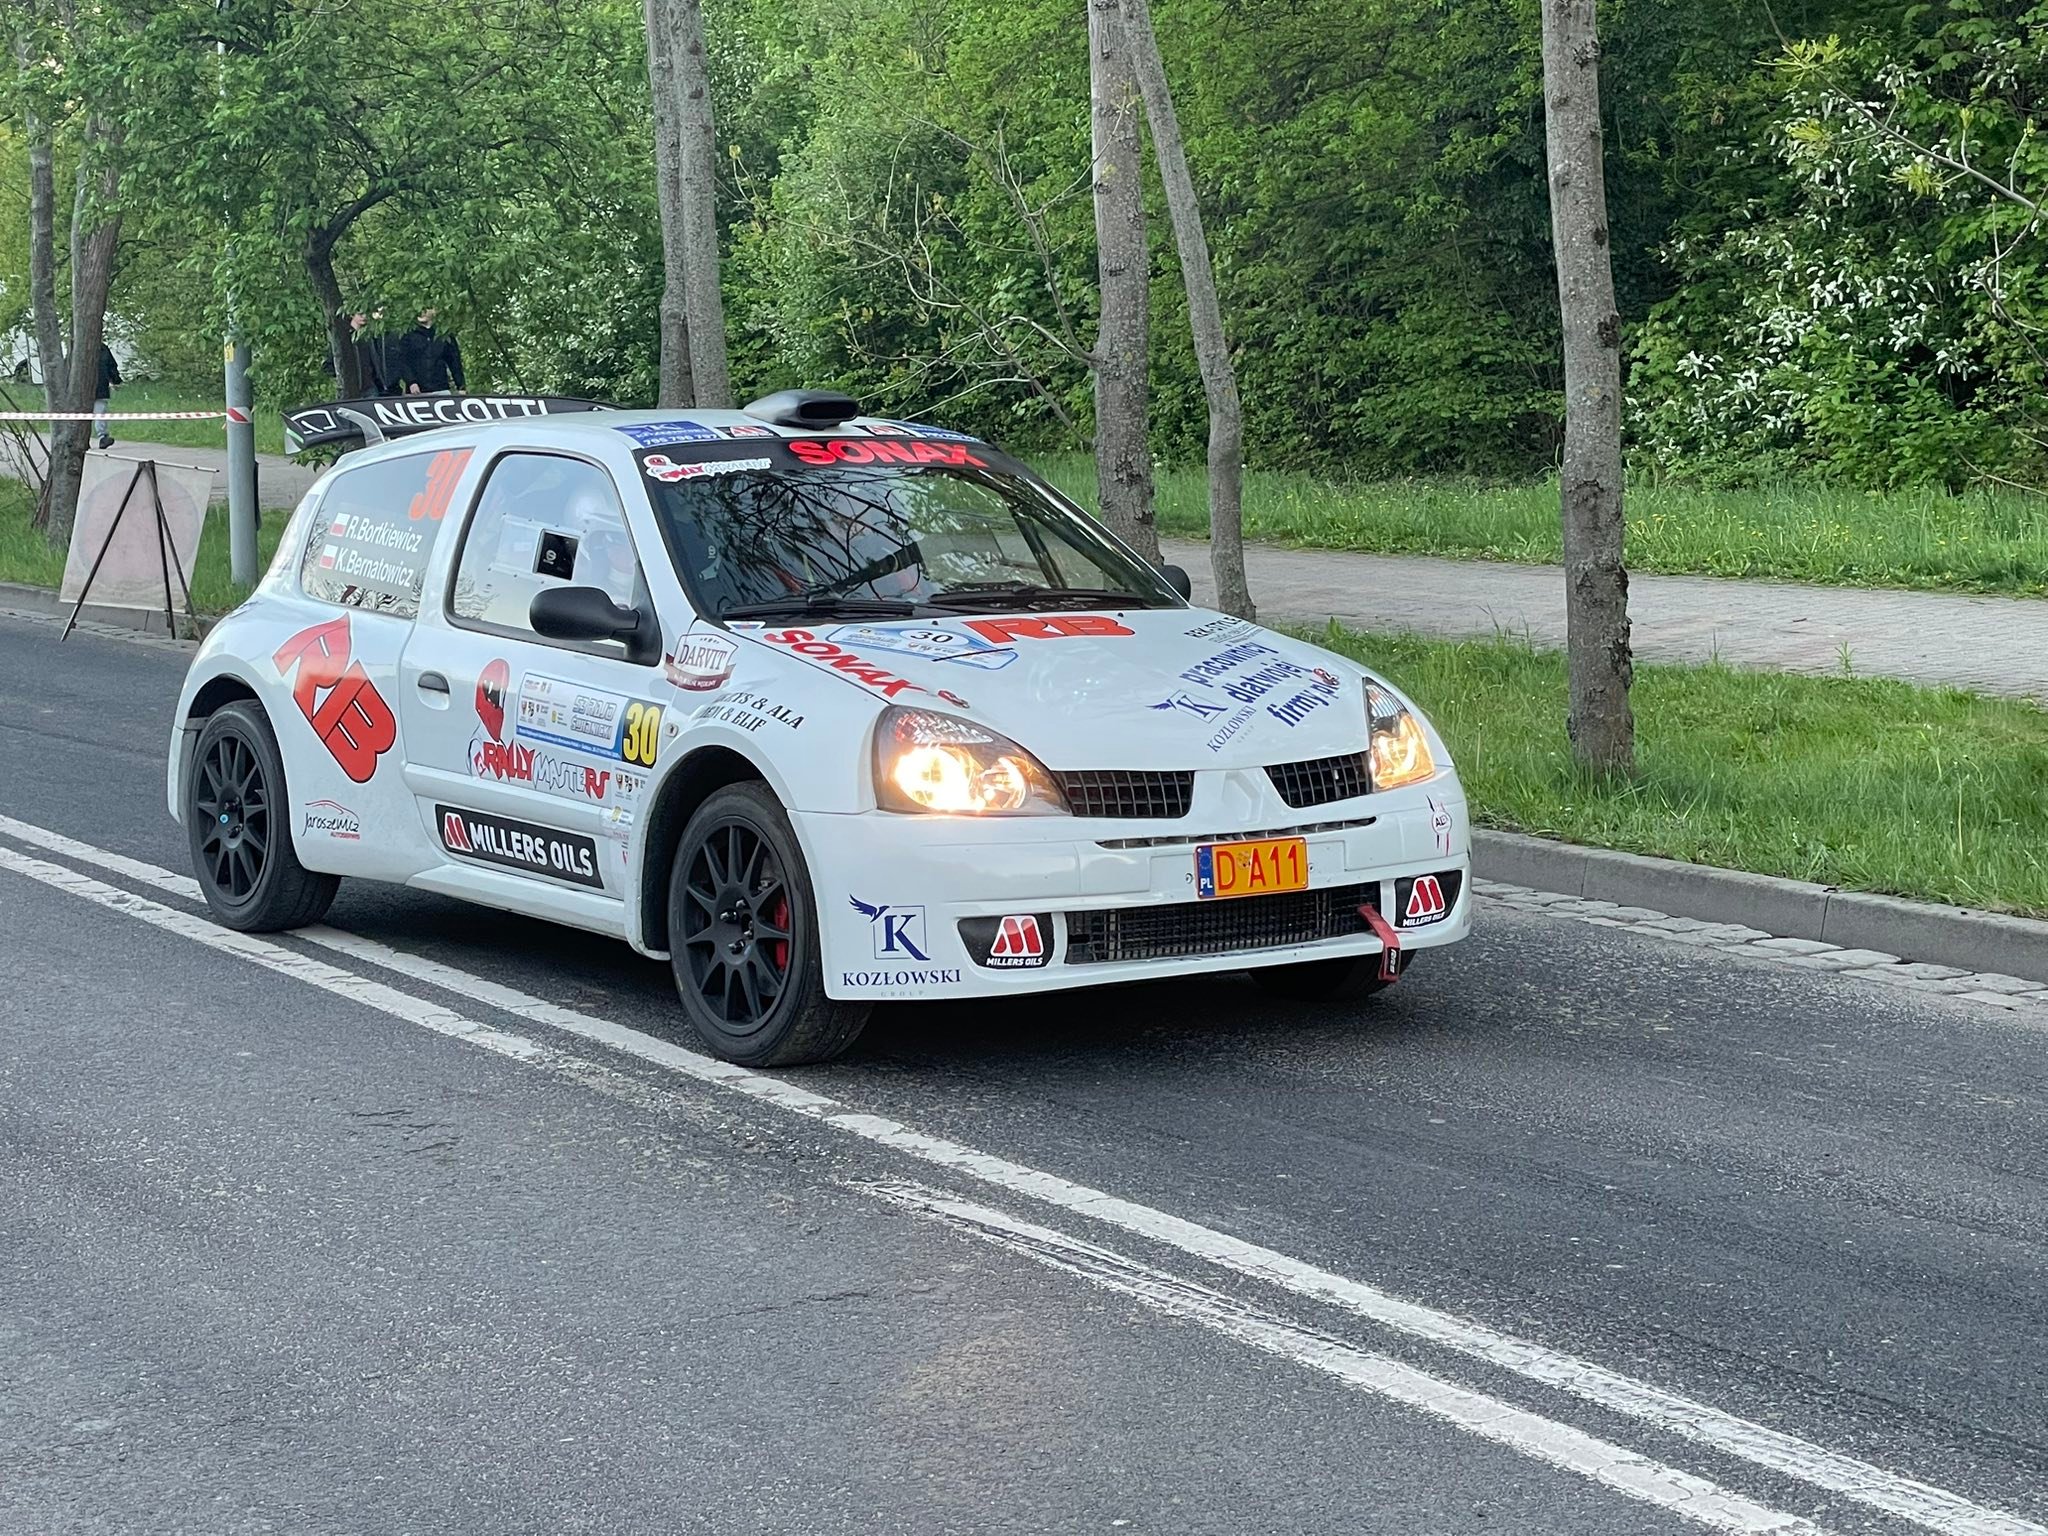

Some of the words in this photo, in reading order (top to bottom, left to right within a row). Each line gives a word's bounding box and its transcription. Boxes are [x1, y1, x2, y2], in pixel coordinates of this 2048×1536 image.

[788, 439, 990, 468] SONAX
[408, 448, 475, 521] 30
[910, 630, 954, 644] 30
[962, 616, 1136, 644] RB
[678, 644, 728, 670] DARVIT
[763, 629, 929, 698] SONAX
[731, 711, 767, 733] ELIF
[766, 704, 805, 730] ALA
[623, 703, 661, 765] 30
[469, 822, 548, 866] MILLERS
[550, 841, 594, 877] OILS
[1200, 878, 1213, 889] PL
[1216, 851, 1236, 890] D
[1248, 844, 1299, 888] A11
[1403, 914, 1432, 927] MILLERS
[986, 957, 1024, 966] MILLERS
[1025, 957, 1043, 965] OILS
[842, 969, 961, 987] KOZŁOWSKI
